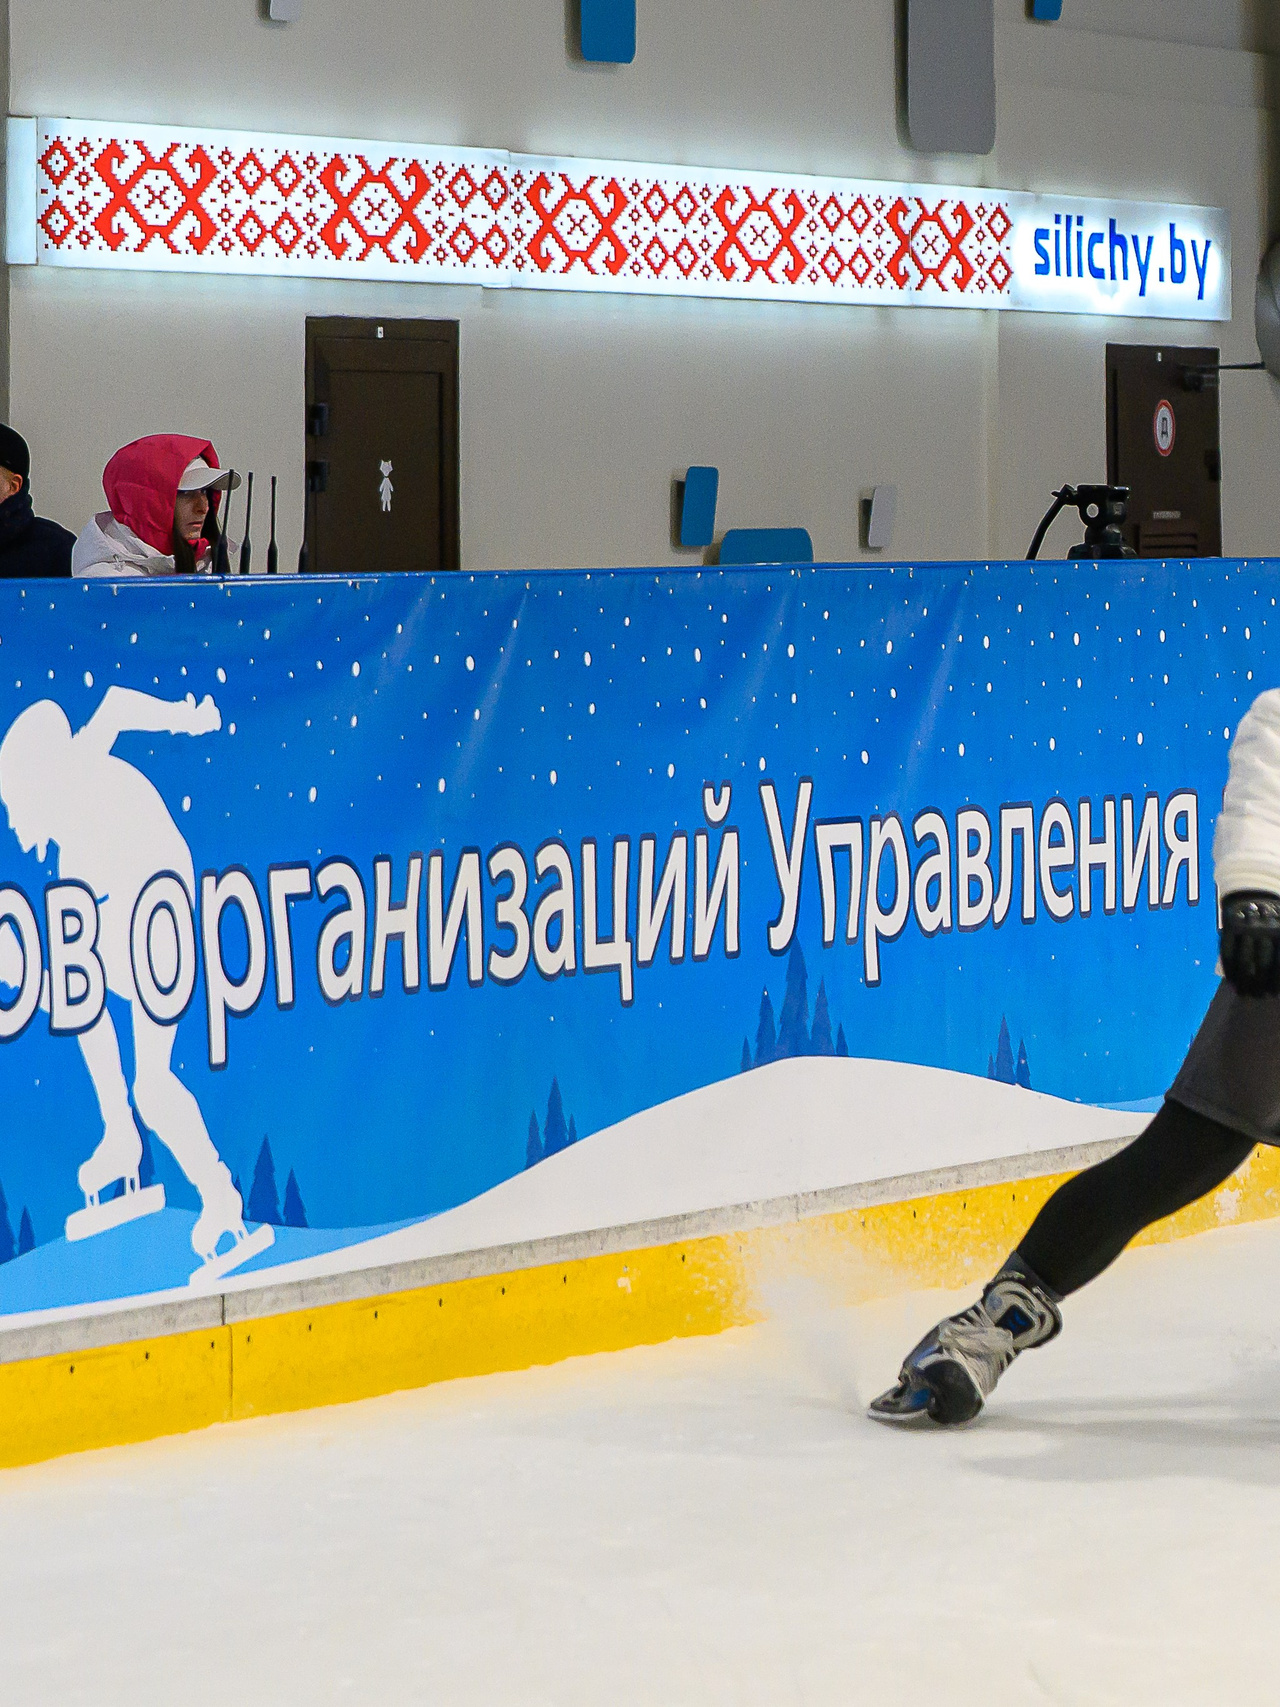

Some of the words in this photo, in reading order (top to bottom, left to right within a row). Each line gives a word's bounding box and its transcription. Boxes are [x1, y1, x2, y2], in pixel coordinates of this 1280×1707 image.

[1033, 213, 1212, 300] silichy.by
[131, 780, 740, 1070] организаций
[758, 776, 1200, 986] Управления
